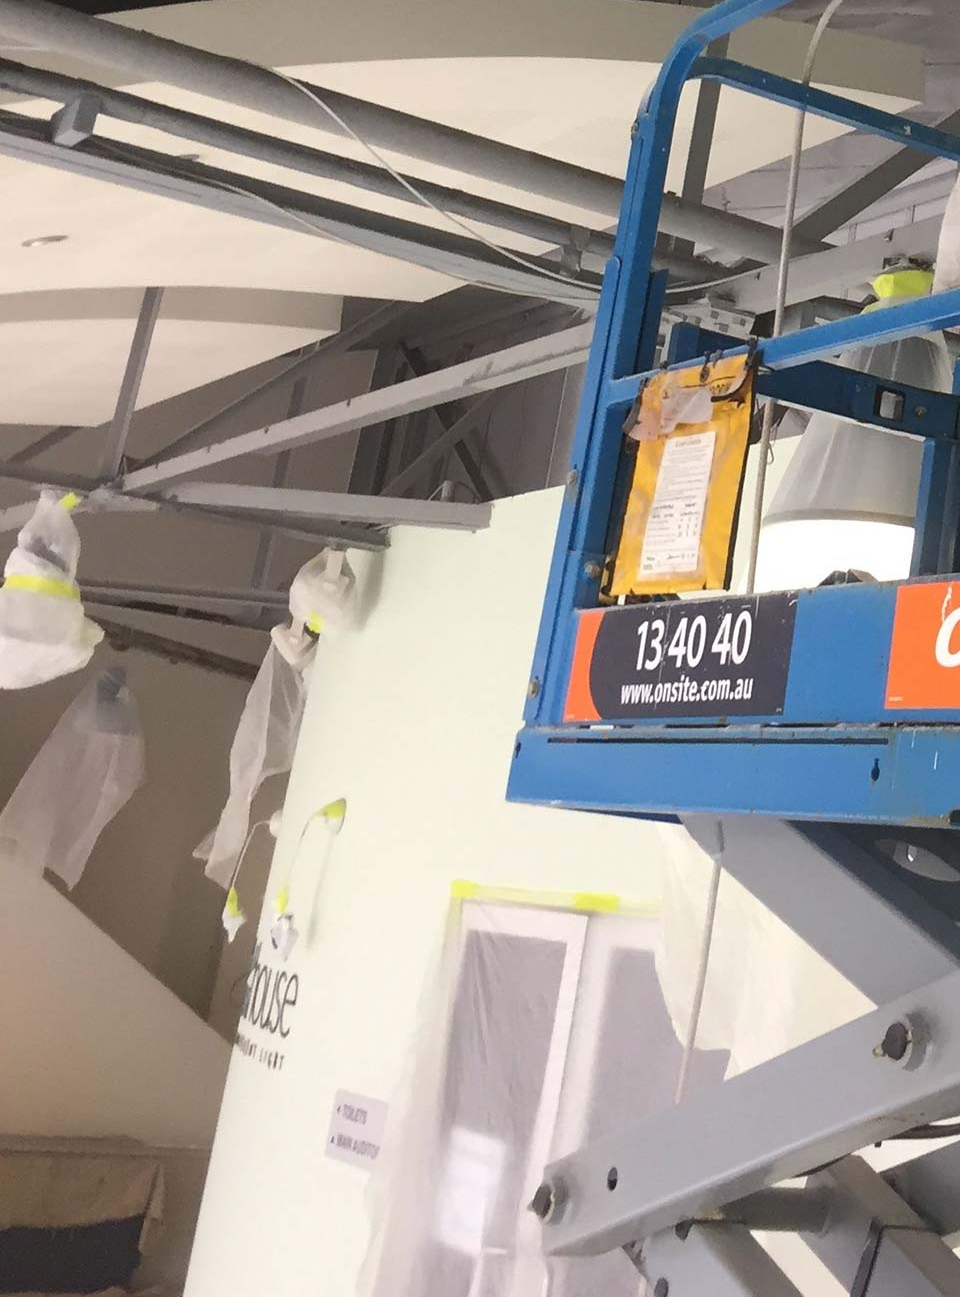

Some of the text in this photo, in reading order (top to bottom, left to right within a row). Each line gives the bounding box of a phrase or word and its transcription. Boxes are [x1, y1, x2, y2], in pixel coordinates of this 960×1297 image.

[636, 610, 752, 670] 13 40 40
[620, 675, 754, 704] www.onsite.com.au
